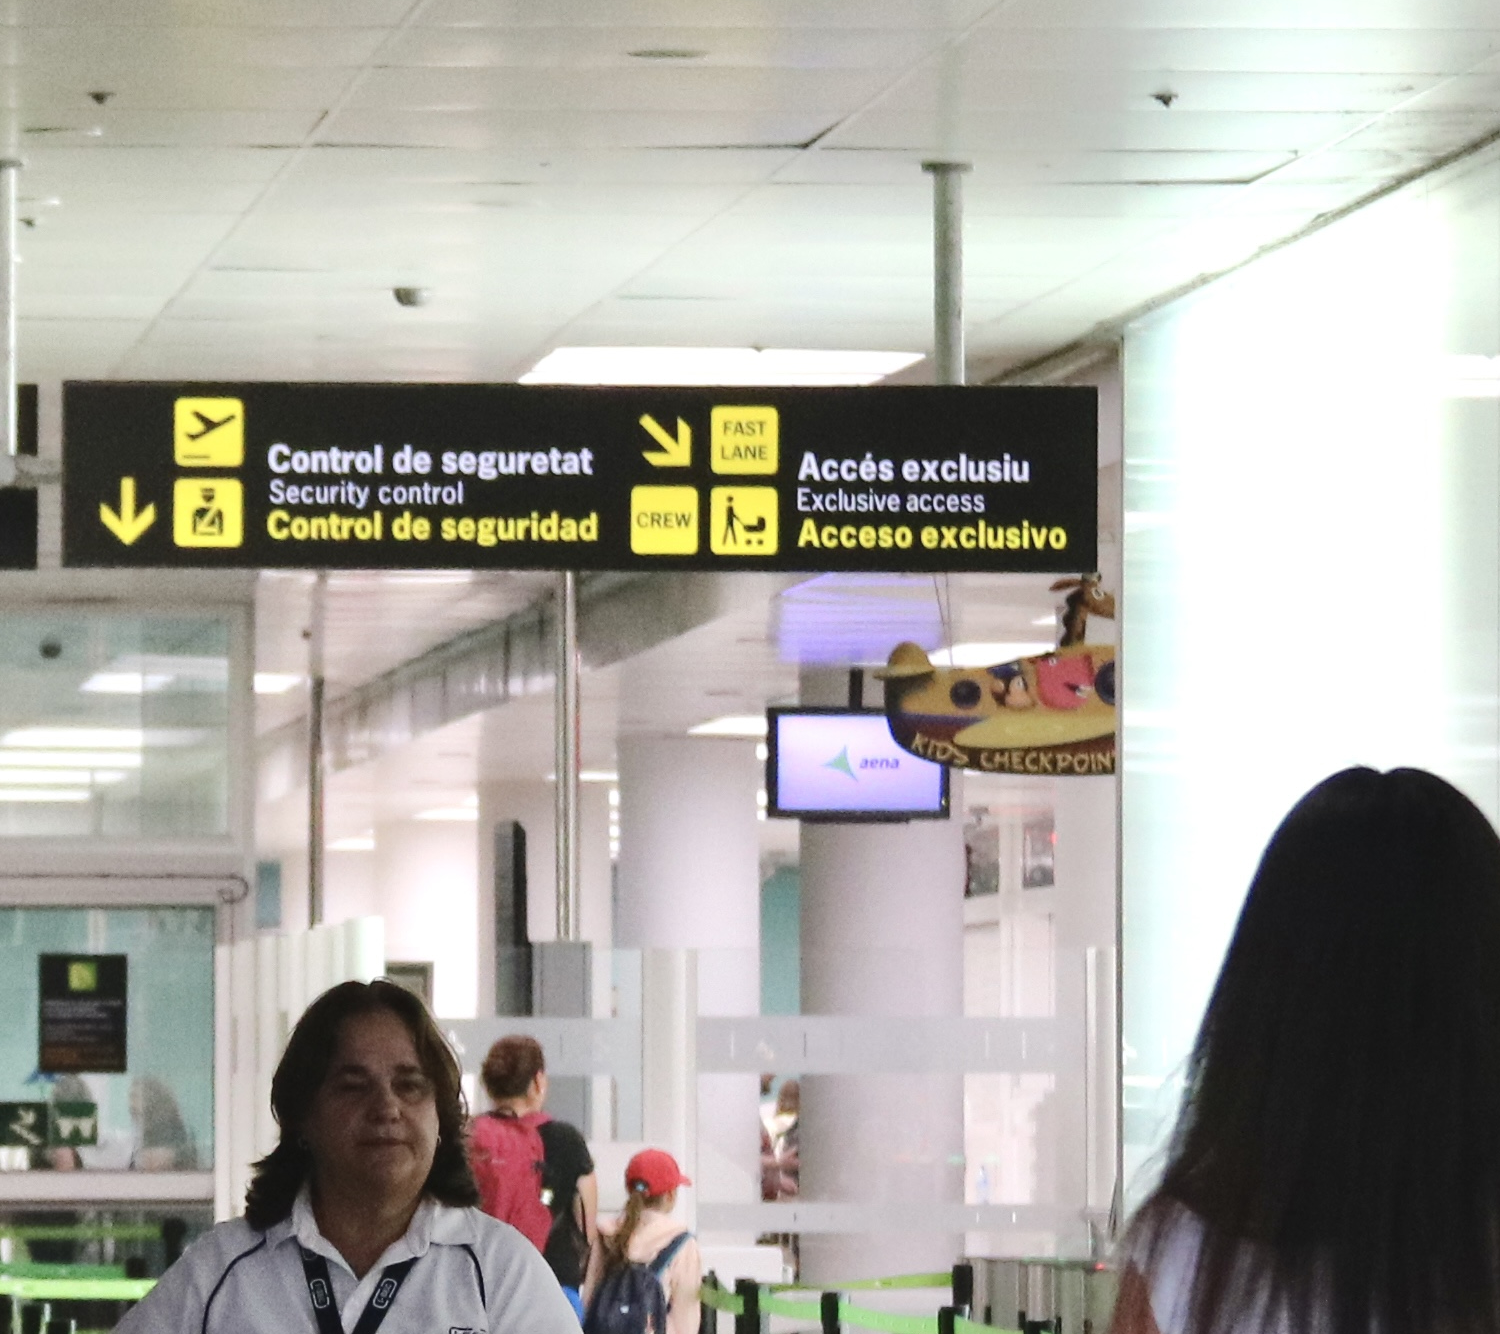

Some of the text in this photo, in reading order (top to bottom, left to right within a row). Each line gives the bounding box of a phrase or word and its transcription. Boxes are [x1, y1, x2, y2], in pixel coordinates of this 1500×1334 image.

[723, 420, 767, 437] FAST
[267, 443, 594, 481] Control de seguretat
[721, 444, 768, 461] LANE
[797, 450, 1030, 483] Accés exclusiu
[268, 478, 464, 510] Security control
[796, 486, 986, 513] Exclusive access
[266, 509, 599, 547] Control de seguridad
[636, 511, 692, 529] CREW
[797, 518, 1067, 550] Acceso exclusivo
[858, 755, 900, 770] aena
[980, 750, 1115, 774] CHECKPOIN
